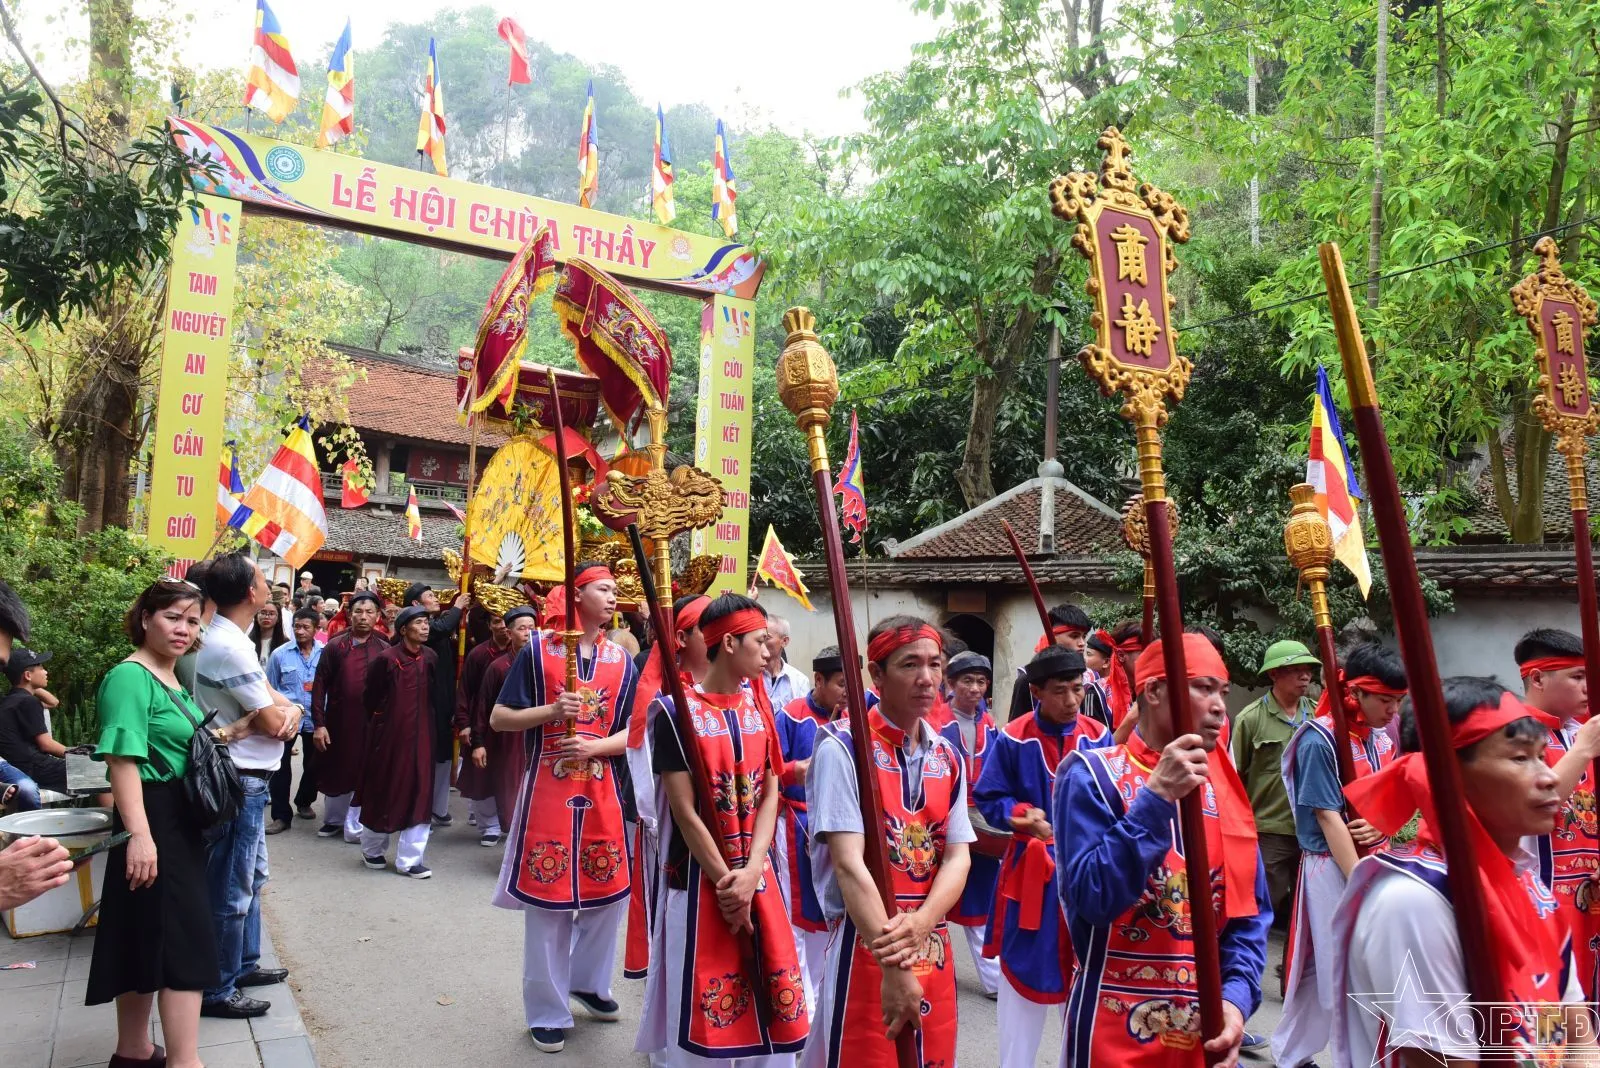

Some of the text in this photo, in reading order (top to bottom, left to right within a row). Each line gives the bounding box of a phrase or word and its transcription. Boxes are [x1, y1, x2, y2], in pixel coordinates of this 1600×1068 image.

[332, 167, 656, 269] LỄ HỘI CHÙA THẦY
[189, 272, 218, 296] TAM
[171, 310, 227, 341] NGUYỆT
[184, 353, 206, 375] AN
[724, 356, 743, 379] CỬU
[181, 393, 204, 416] CƯ
[173, 427, 204, 457] CẦN
[722, 421, 740, 443] KẾT
[722, 456, 739, 476] TÚC
[176, 475, 194, 497] TU
[166, 513, 197, 539] GIỚI
[716, 520, 741, 545] NIỆM
